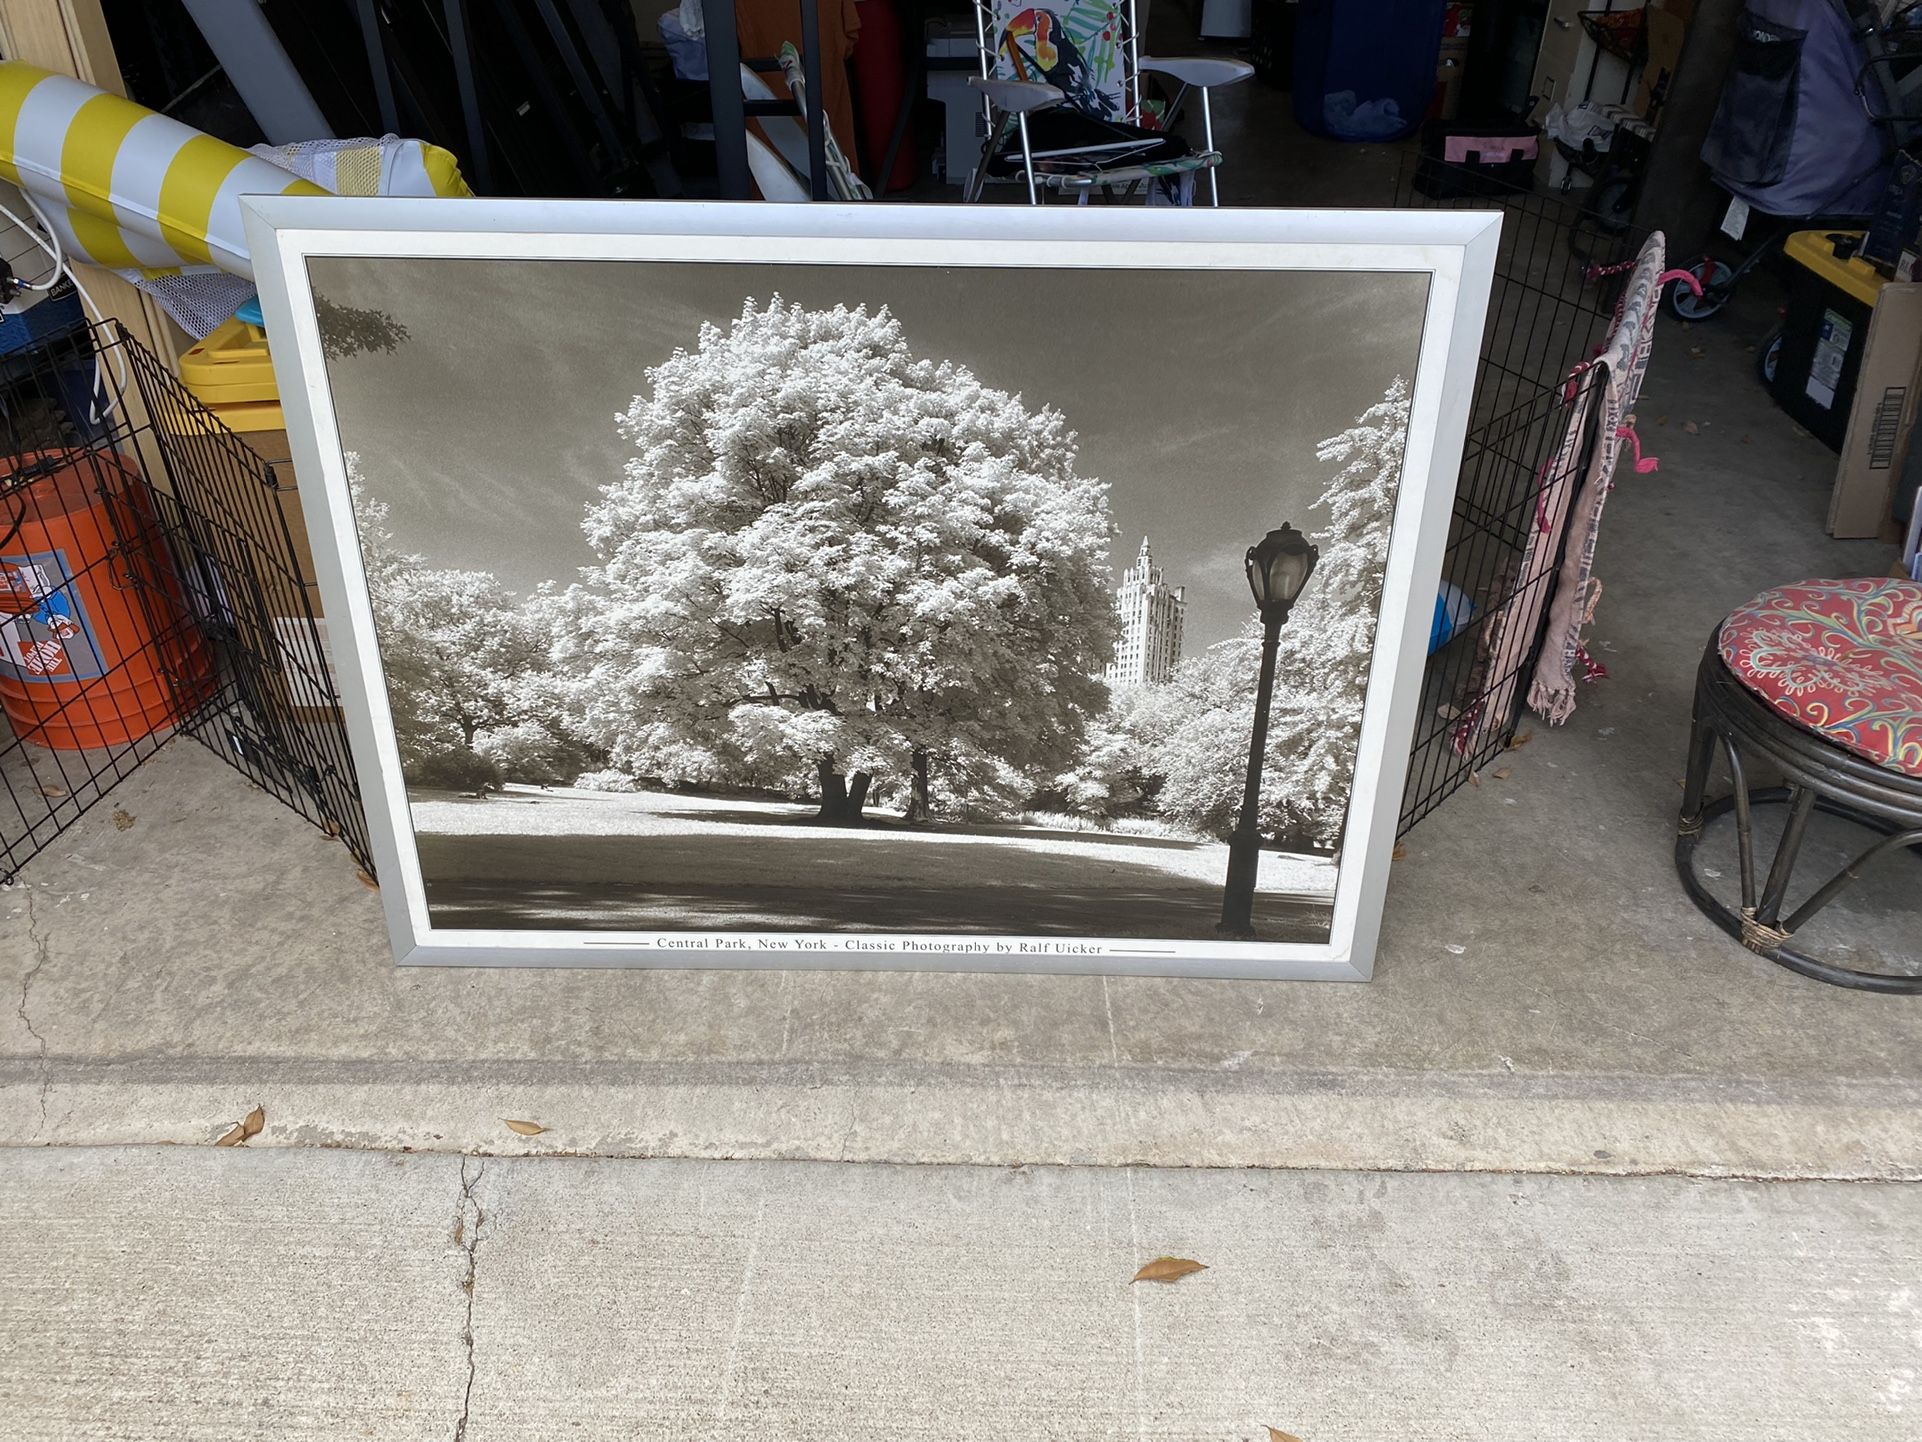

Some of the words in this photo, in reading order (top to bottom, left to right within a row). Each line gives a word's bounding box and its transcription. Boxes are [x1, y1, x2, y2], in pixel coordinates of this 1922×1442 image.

[46, 657, 63, 672] THE
[656, 937, 709, 949] Central
[715, 938, 752, 951] Park,
[758, 939, 788, 949] New
[794, 939, 827, 950] York
[845, 939, 896, 951] Classic
[902, 940, 990, 954] Photography
[996, 942, 1013, 954] by
[1019, 942, 1050, 953] Ralf
[1055, 943, 1103, 955] Uicker
